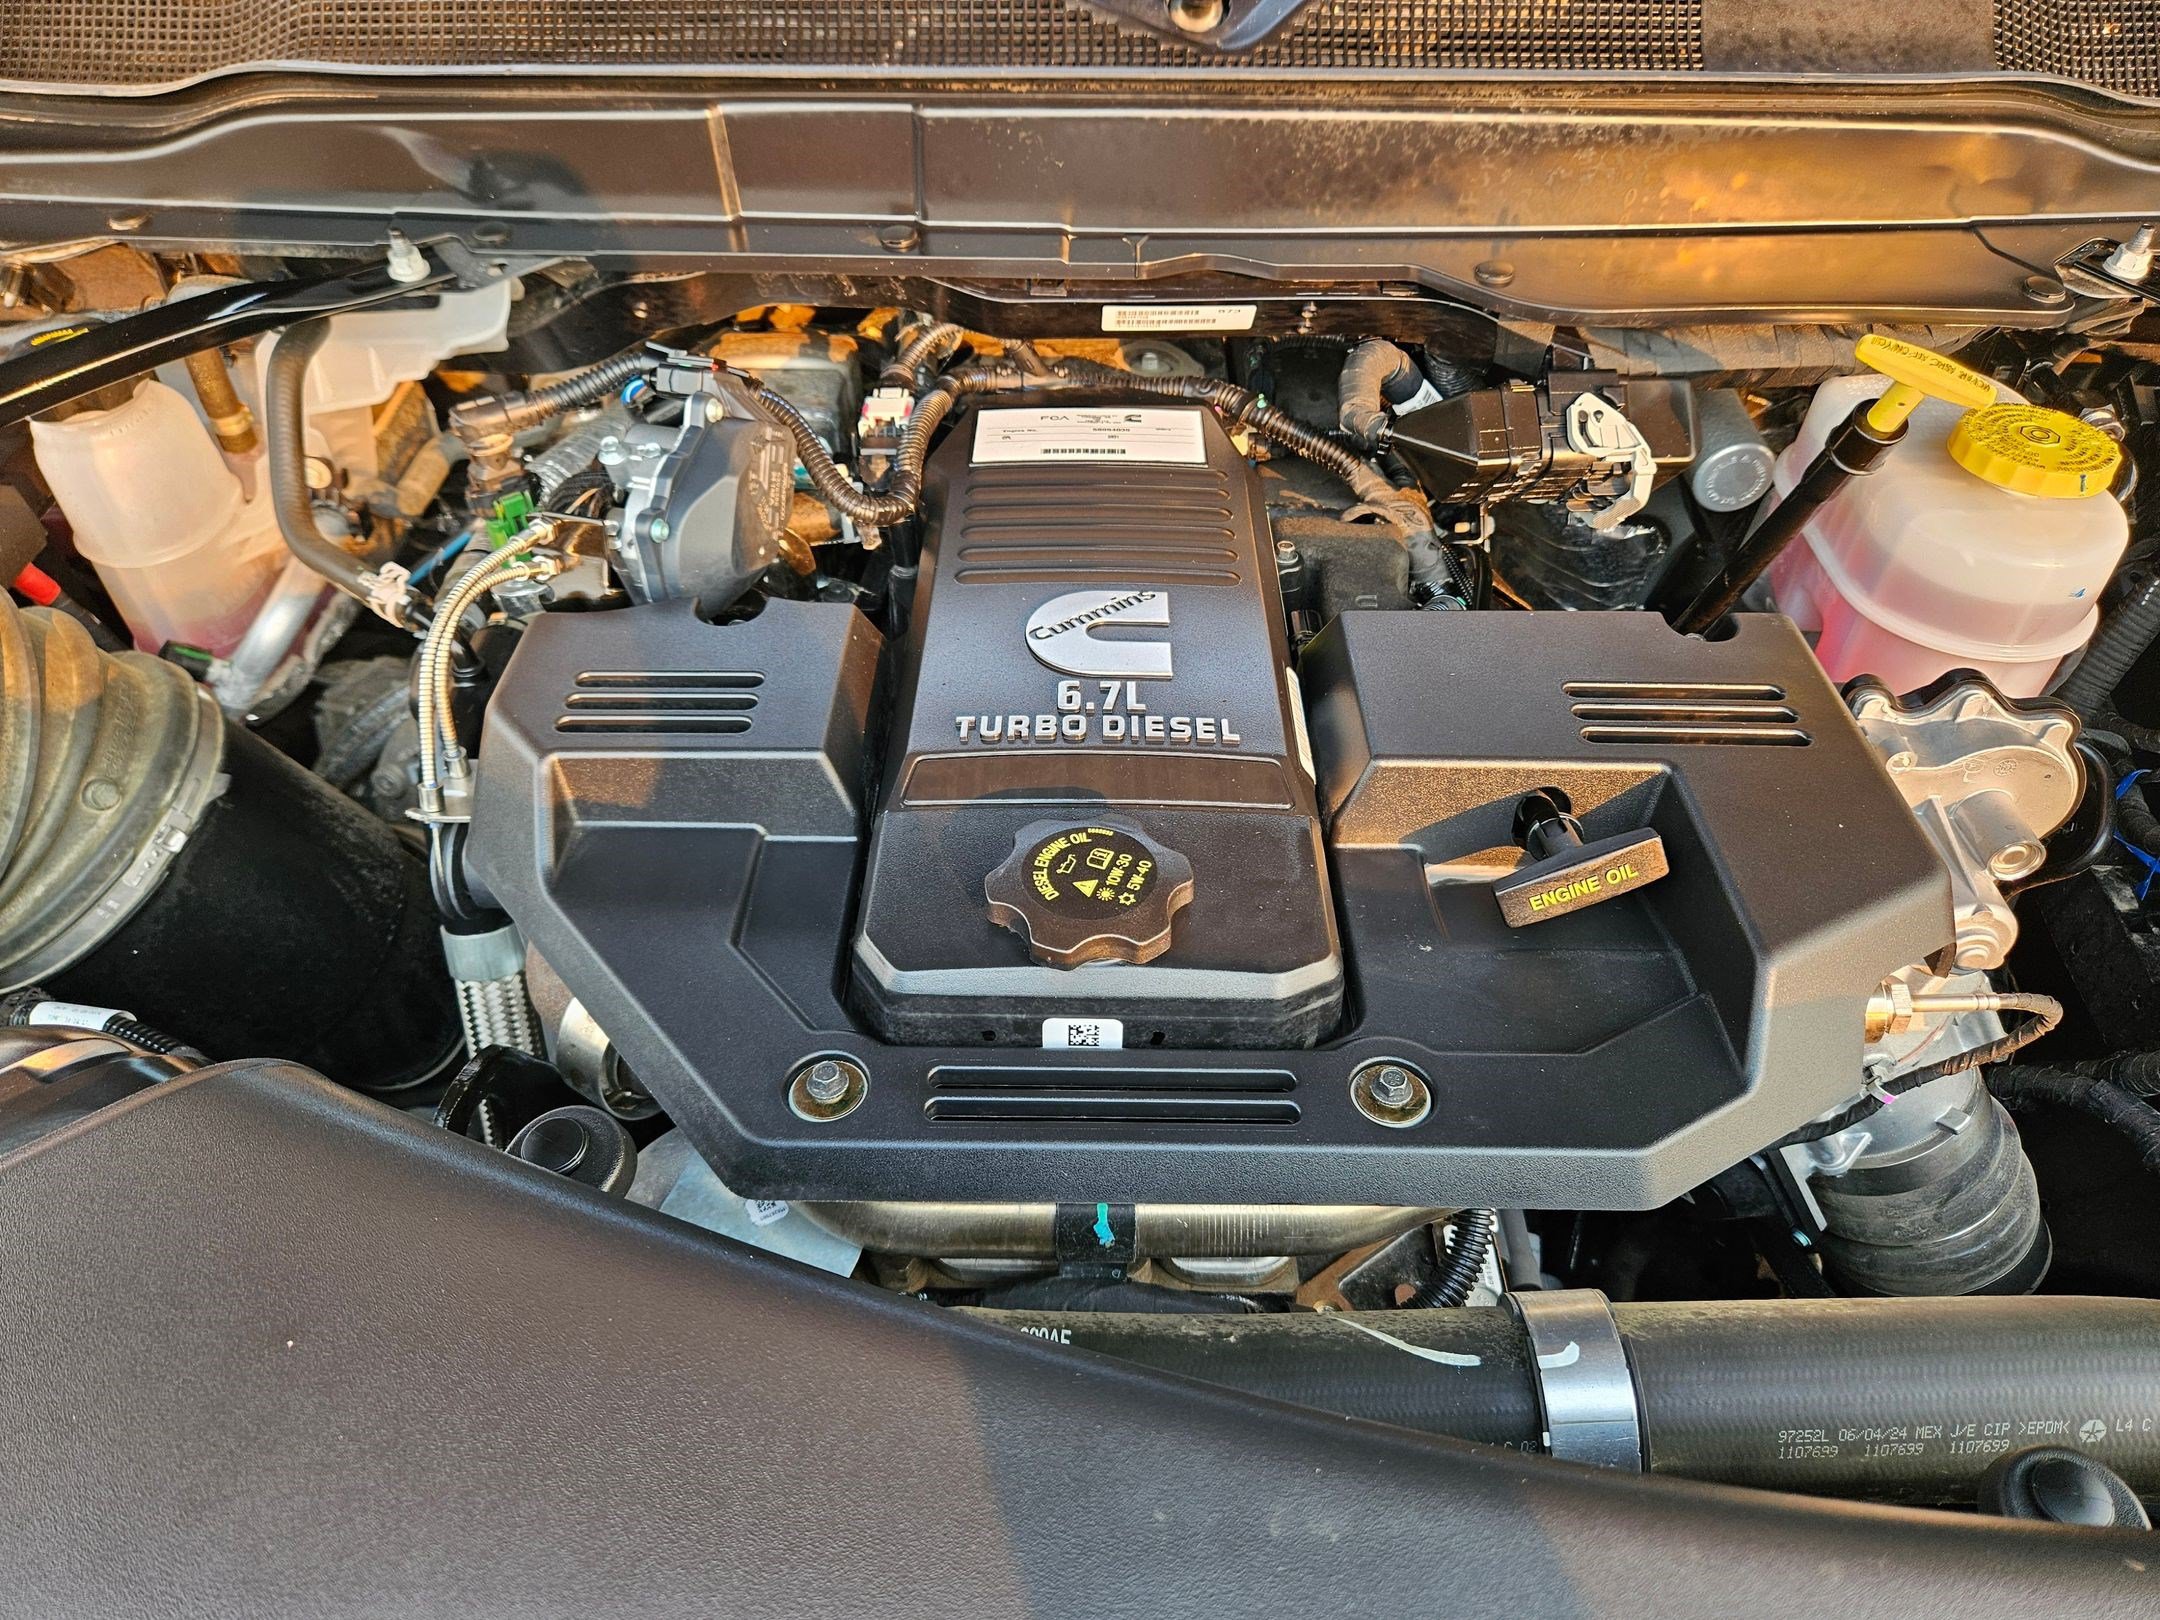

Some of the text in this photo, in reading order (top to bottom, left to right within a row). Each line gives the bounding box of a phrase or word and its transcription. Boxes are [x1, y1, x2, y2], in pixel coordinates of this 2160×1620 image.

[1028, 590, 1156, 641] Cummins
[1057, 680, 1146, 714] 6.7L
[956, 714, 1240, 744] TURBO DIESEL
[1032, 832, 1092, 901] DIESEL ENGINE OIL
[1105, 853, 1133, 886] 10W-30
[1126, 860, 1153, 891] 5W-40
[1528, 863, 1640, 912] ENGINE OIL
[1778, 1429, 1830, 1443] 97252L
[1838, 1426, 1908, 1442] 06/04/24
[1915, 1425, 1943, 1439] MEX
[1950, 1423, 1977, 1438] J/E
[1984, 1422, 2011, 1436] CIP
[2115, 1418, 2134, 1432] L4
[1778, 1439, 2010, 1460] 1107699 1107699 1107699
